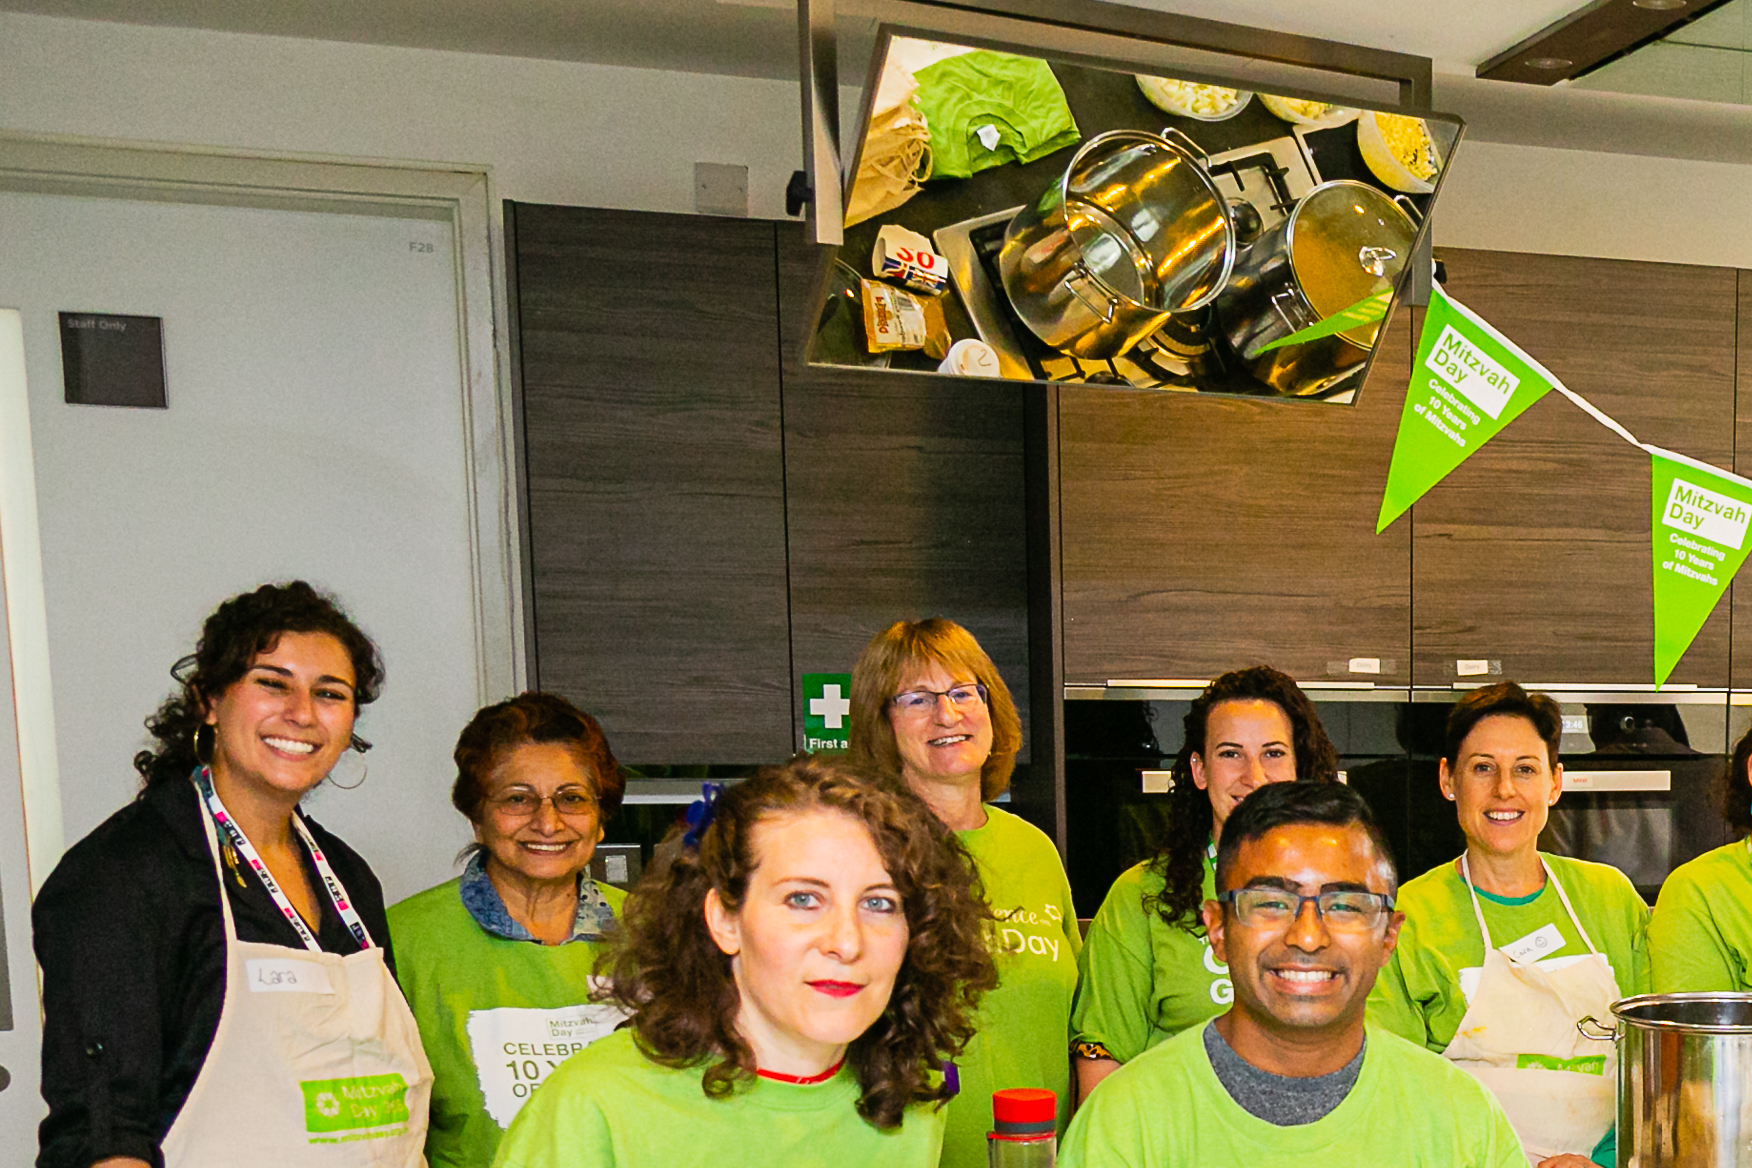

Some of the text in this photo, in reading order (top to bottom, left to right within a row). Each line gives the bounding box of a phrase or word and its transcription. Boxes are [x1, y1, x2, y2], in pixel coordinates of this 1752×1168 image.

[67, 318, 126, 332] Staff Only
[1433, 348, 1468, 384] Day
[1442, 332, 1510, 395] Mitzvah
[1428, 378, 1481, 425] Celebrating
[1428, 396, 1467, 431] 10 Years
[1413, 403, 1466, 447] of Mitzvahs
[1669, 502, 1704, 530] Day
[1674, 485, 1746, 524] Mitzvah
[1669, 532, 1726, 562] Celebrating
[1674, 548, 1714, 571] 10 Years
[1662, 560, 1718, 586] of Mitzvahs
[809, 738, 839, 749] First
[1002, 928, 1059, 962] Day
[258, 968, 298, 986] Lara
[550, 1017, 593, 1028] Mitzvah
[551, 1028, 573, 1037] Day
[503, 1042, 586, 1056] CELEBR
[506, 1059, 540, 1081] 10
[350, 1103, 377, 1121] Day
